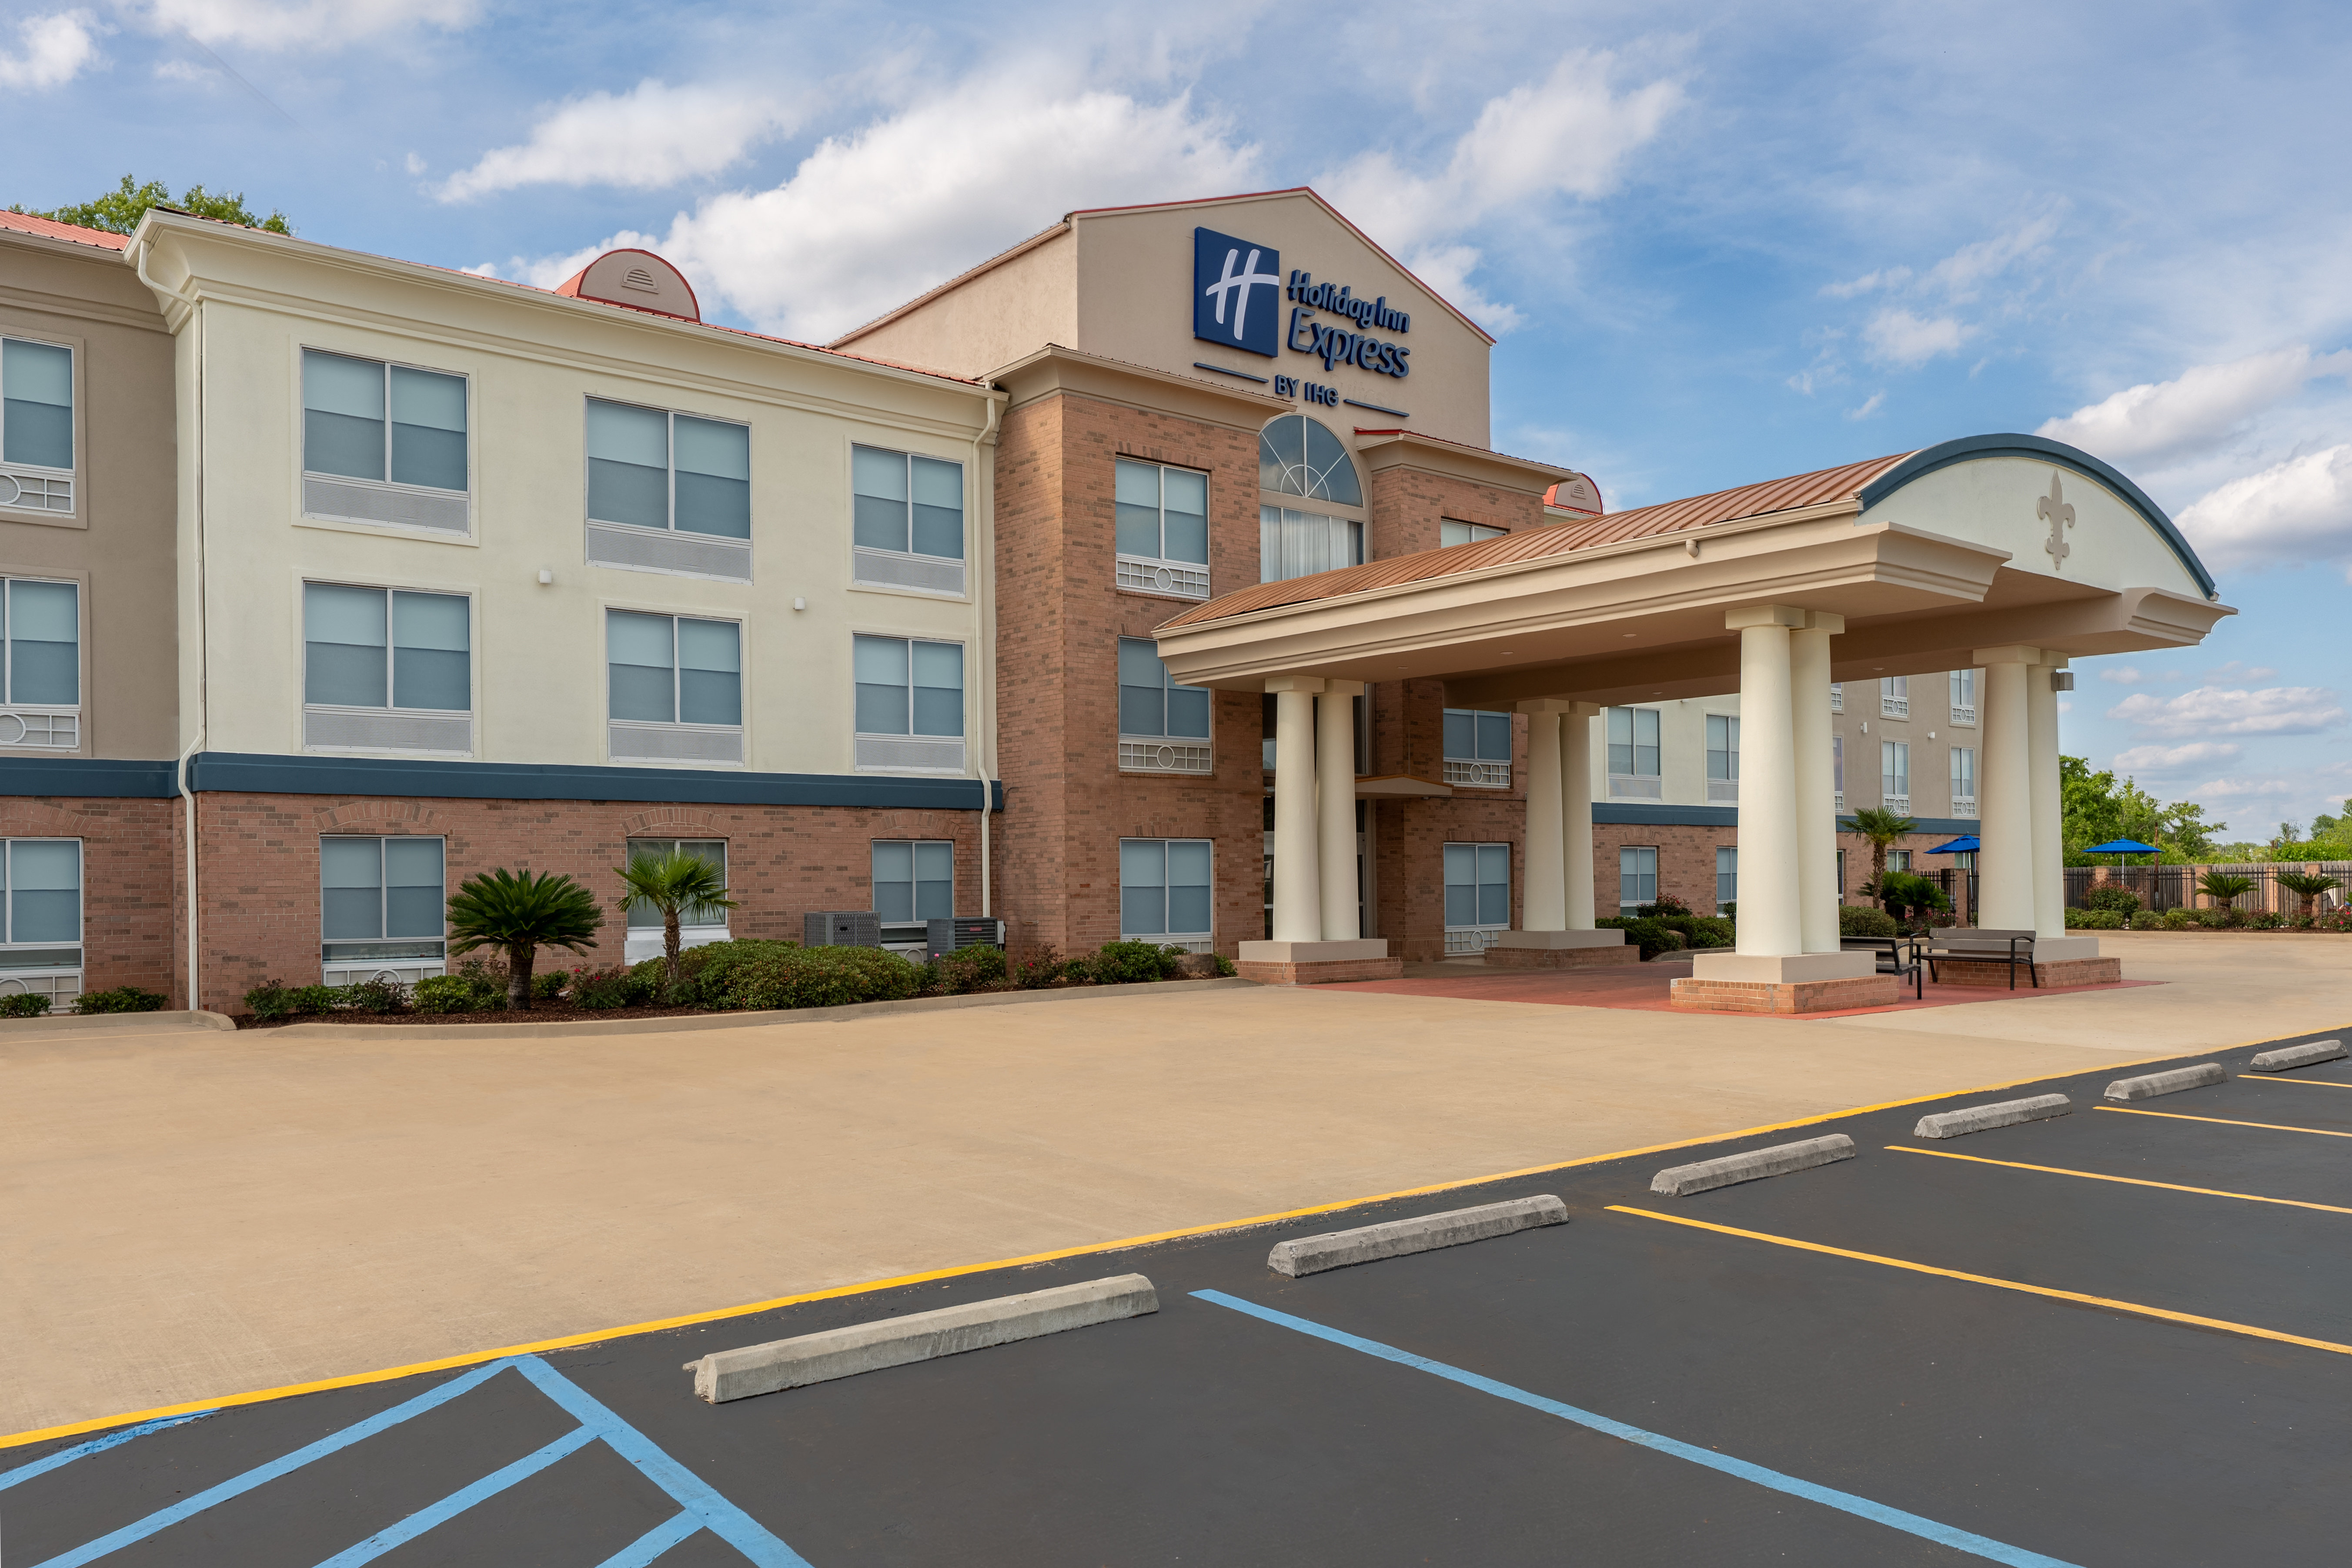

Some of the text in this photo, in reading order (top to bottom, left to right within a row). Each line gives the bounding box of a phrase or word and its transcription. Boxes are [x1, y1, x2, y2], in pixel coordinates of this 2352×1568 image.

[1287, 269, 1410, 333] Holiday Inn
[1287, 307, 1410, 378] Express
[1275, 374, 1338, 406] BY IHG
